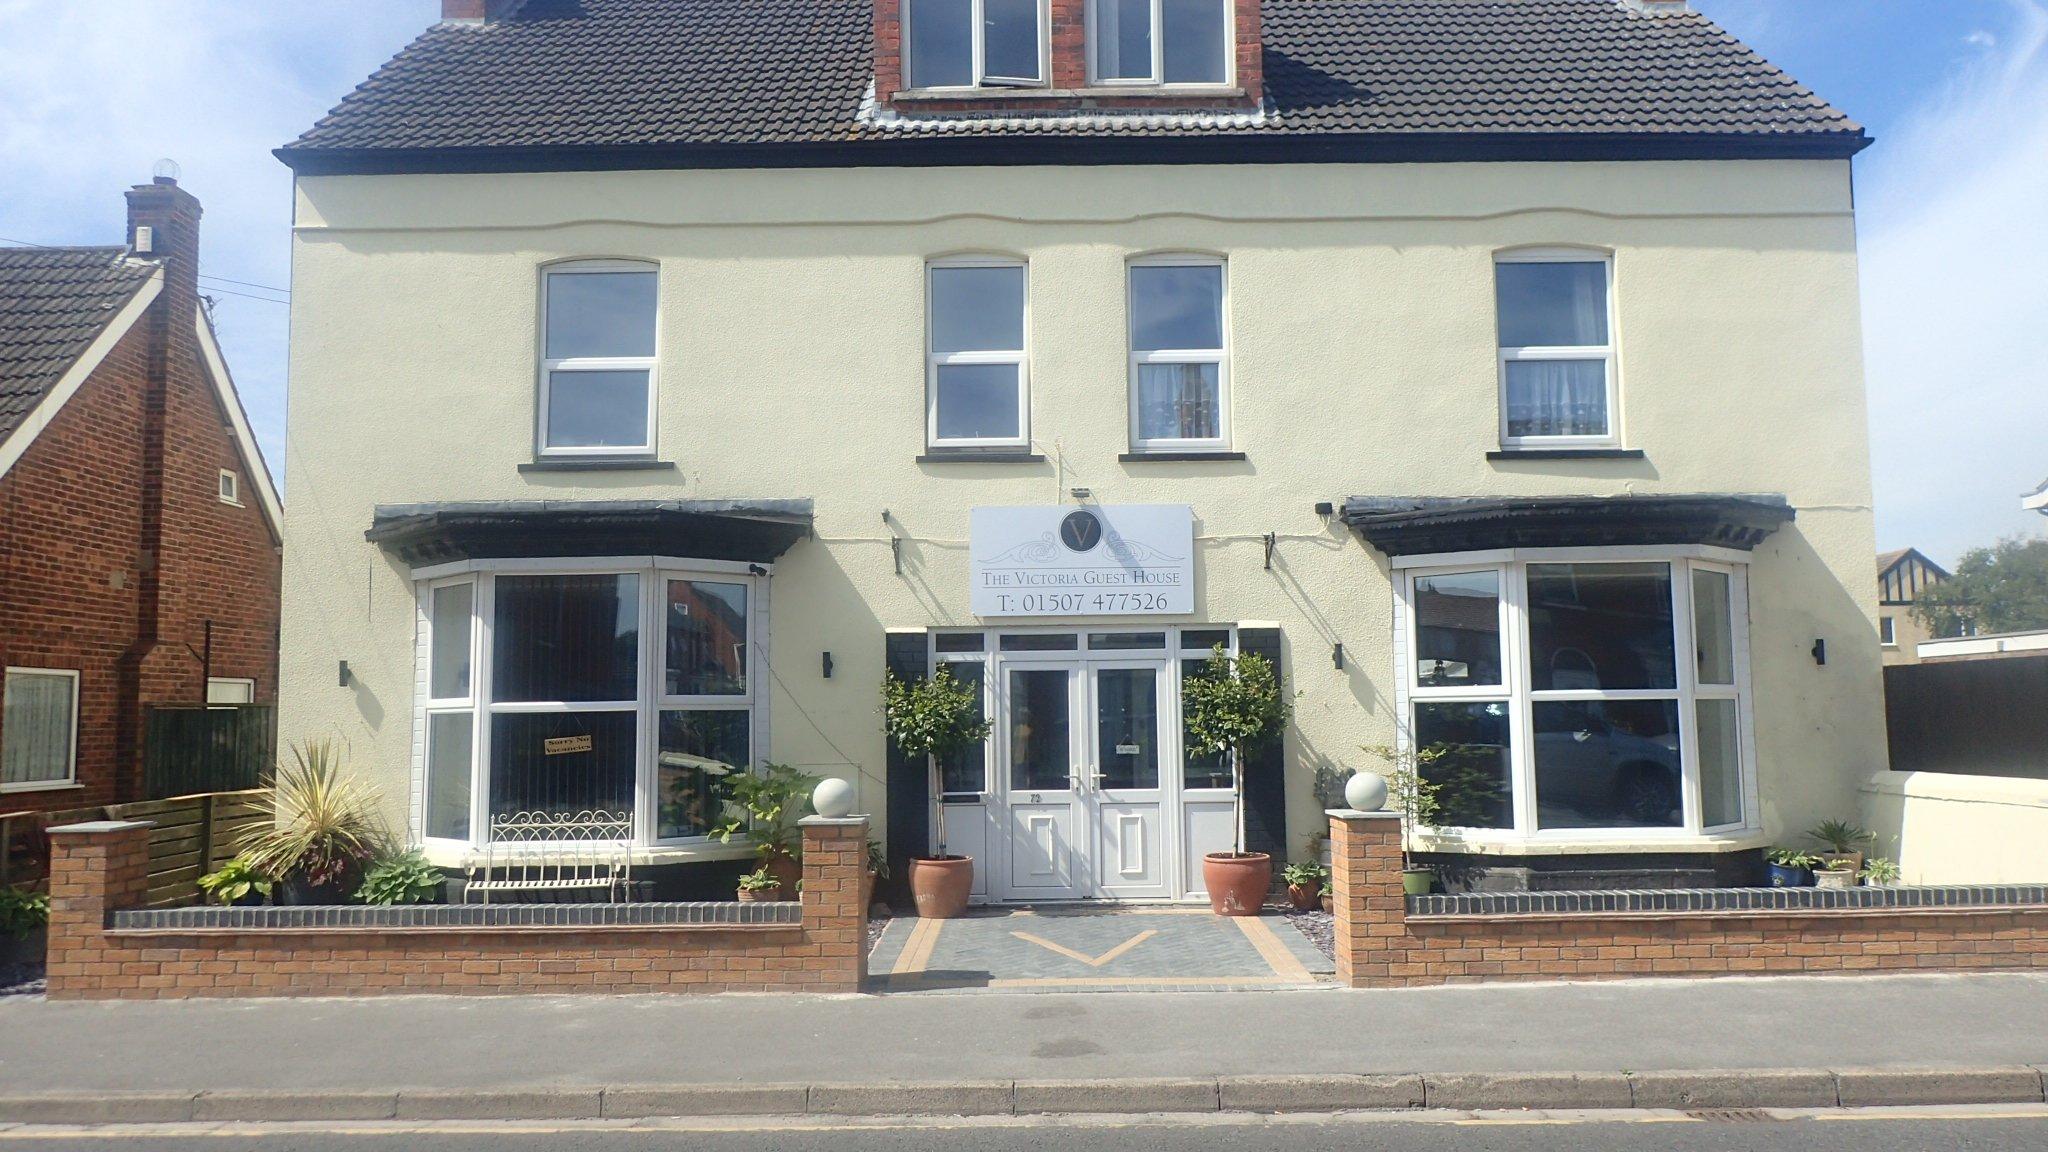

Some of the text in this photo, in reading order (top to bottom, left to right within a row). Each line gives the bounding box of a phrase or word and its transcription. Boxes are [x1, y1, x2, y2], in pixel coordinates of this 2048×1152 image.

[1068, 519, 1092, 547] V
[981, 570, 1180, 586] THE VICTORIA GUEST HOUSE
[997, 592, 1168, 612] T: 01507 477526
